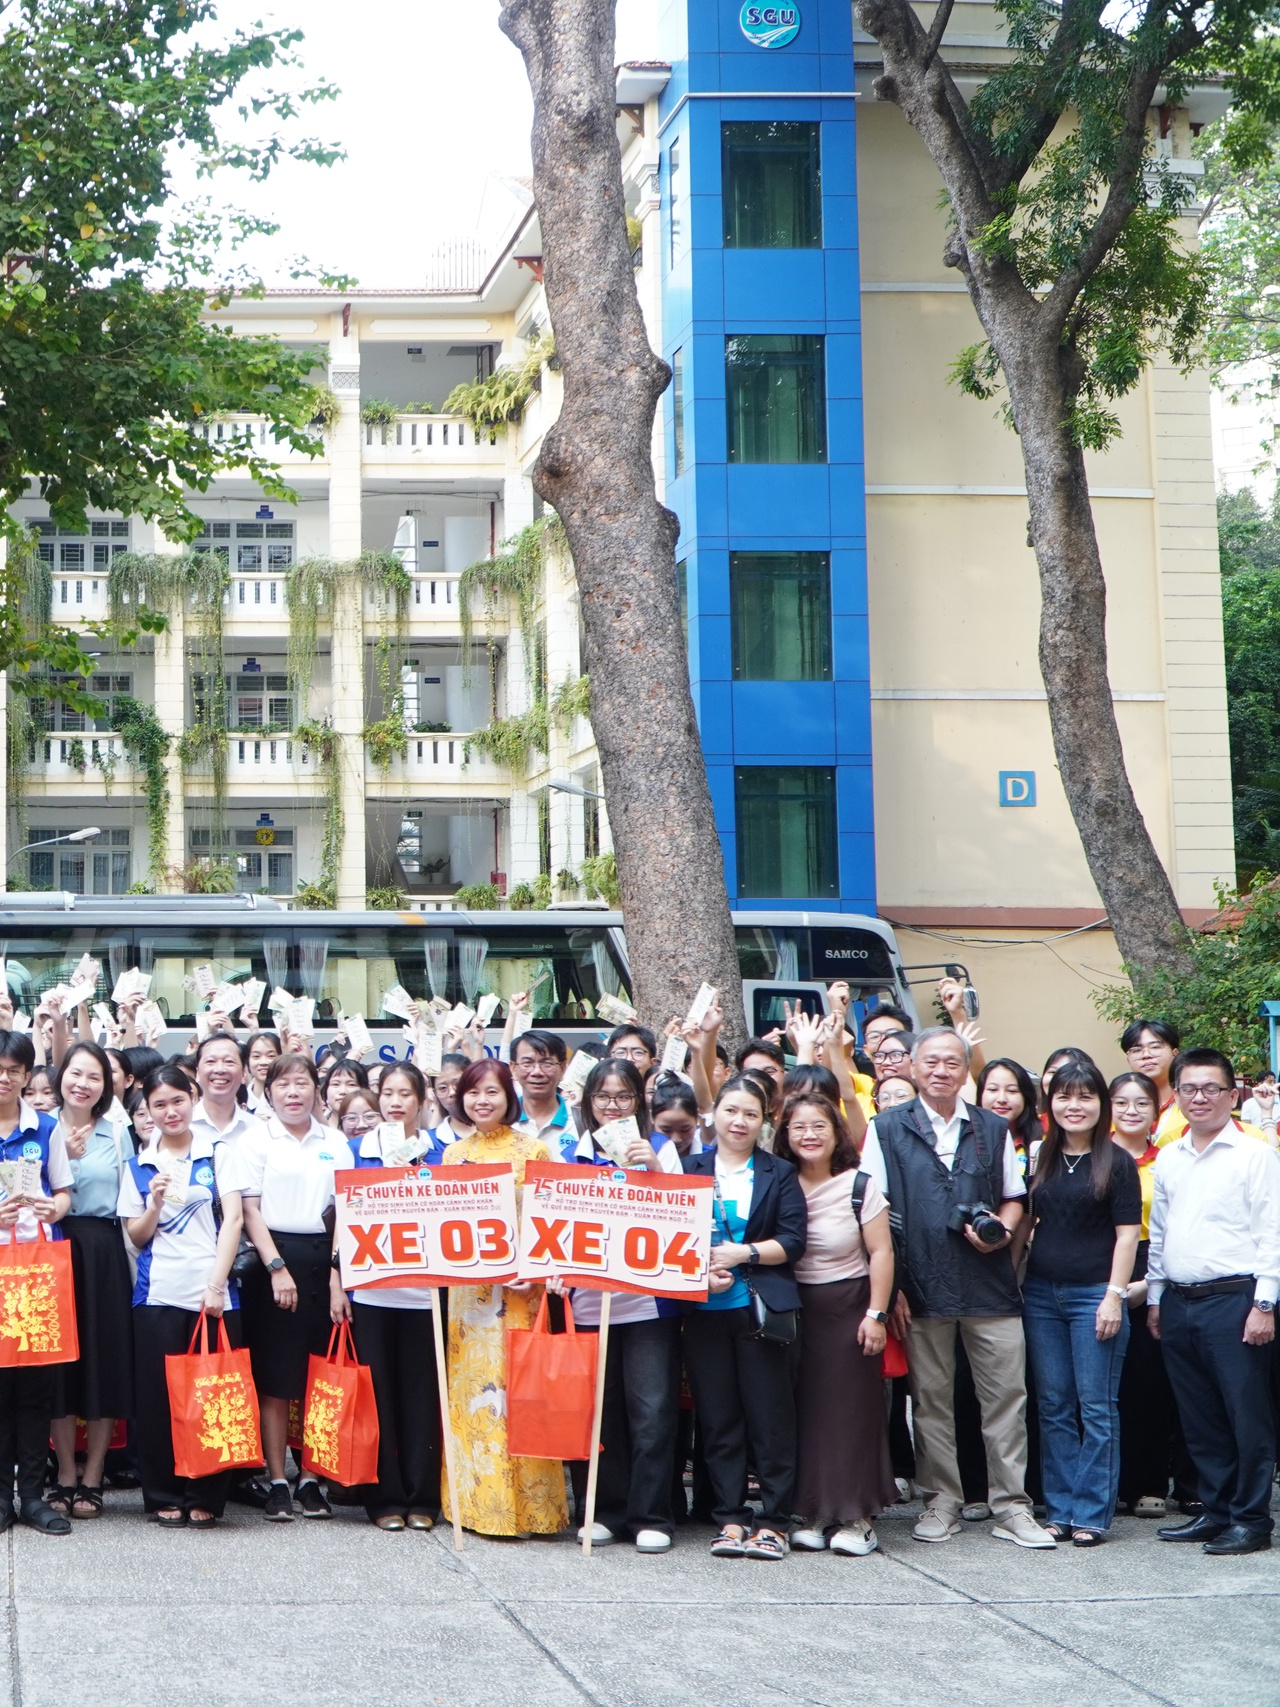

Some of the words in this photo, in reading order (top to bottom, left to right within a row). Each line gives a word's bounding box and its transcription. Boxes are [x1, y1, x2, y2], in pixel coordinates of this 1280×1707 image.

[747, 7, 795, 25] SGU
[1006, 777, 1029, 801] D
[825, 949, 869, 959] SAMCO
[24, 1147, 39, 1155] SGU
[366, 1180, 413, 1199] CHUYẾN
[416, 1185, 432, 1197] XE
[435, 1180, 468, 1196] ĐOÀN
[471, 1179, 499, 1194] VIÊN
[556, 1179, 604, 1198] CHUYẾN
[608, 1187, 624, 1200] XE
[627, 1187, 662, 1203] ĐOÀN
[666, 1191, 696, 1207] VIÊN
[347, 1222, 423, 1265] XE
[440, 1219, 510, 1262] 03
[527, 1216, 605, 1265] XE
[624, 1226, 702, 1275] 04
